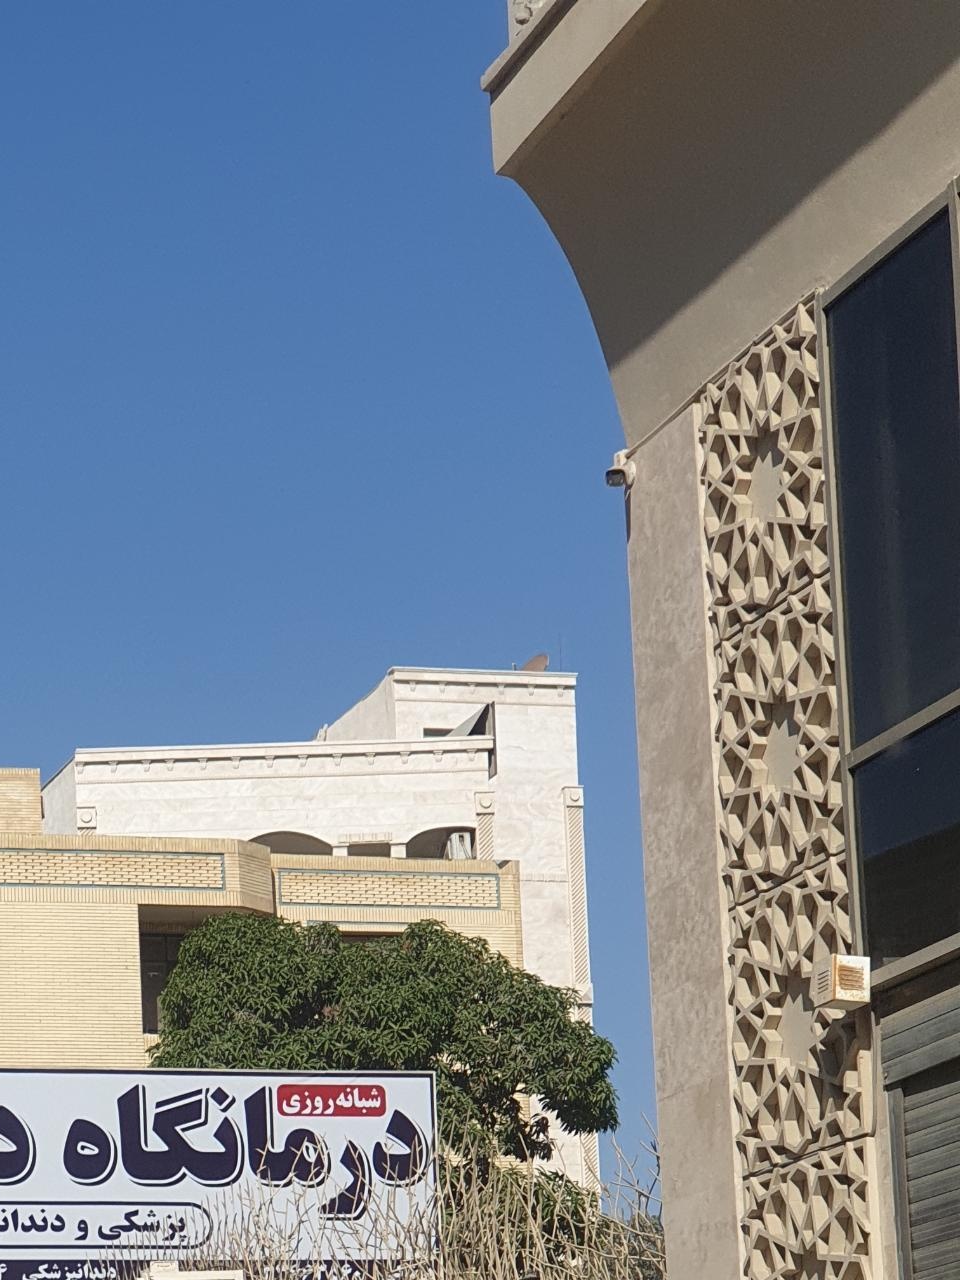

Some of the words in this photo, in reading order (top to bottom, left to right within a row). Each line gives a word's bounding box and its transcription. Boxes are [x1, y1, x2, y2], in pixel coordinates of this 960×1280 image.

[63, 1084, 429, 1220] درمانگاه
[74, 1218, 89, 1240] و
[98, 1209, 186, 1241] پزشکی
